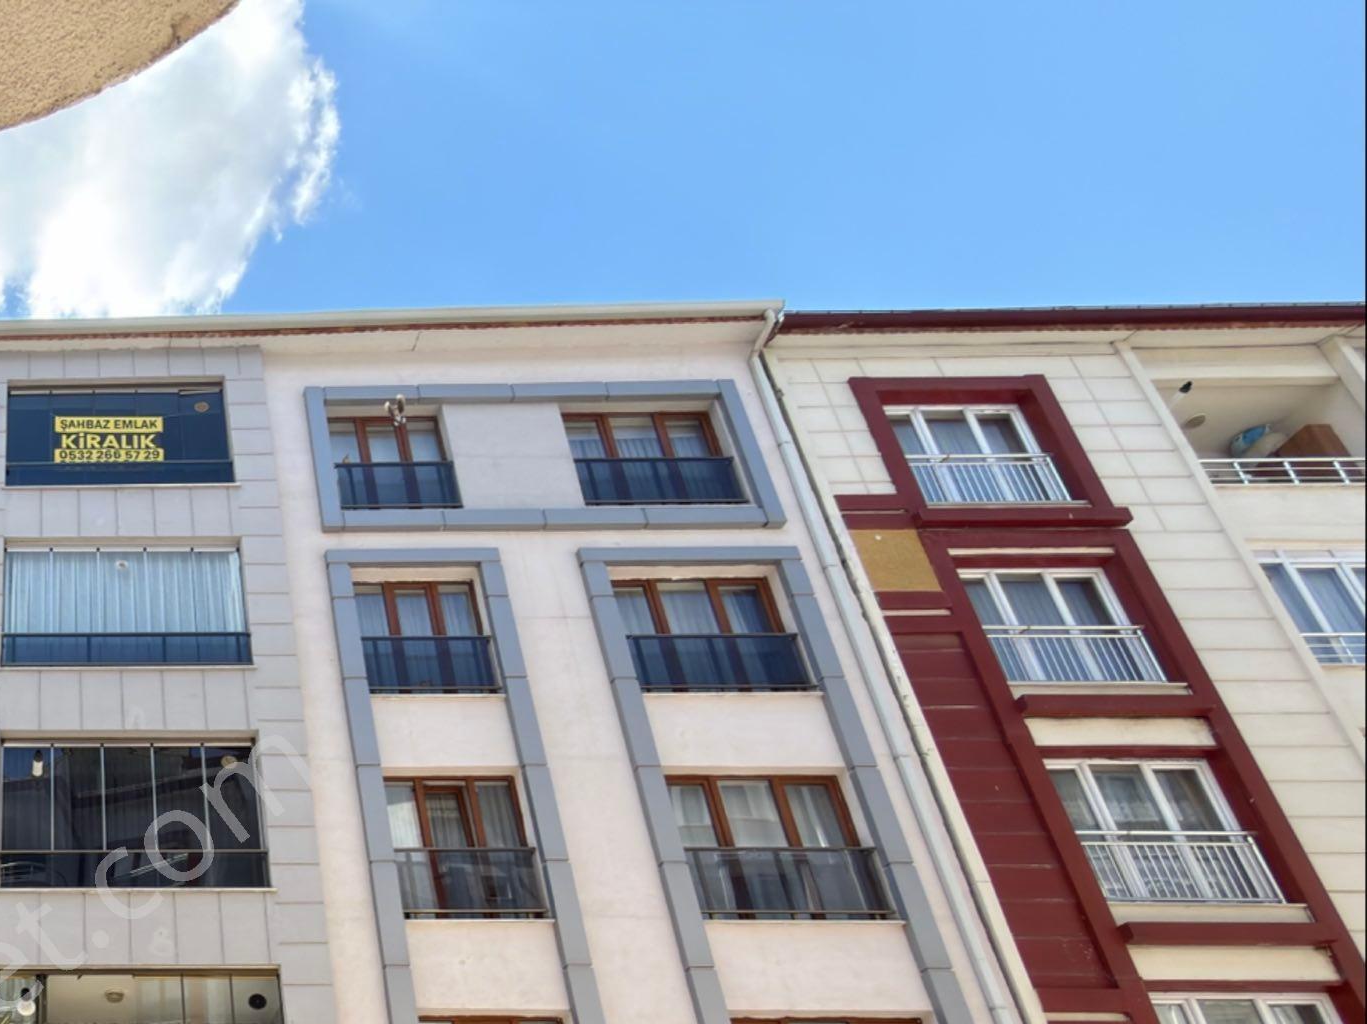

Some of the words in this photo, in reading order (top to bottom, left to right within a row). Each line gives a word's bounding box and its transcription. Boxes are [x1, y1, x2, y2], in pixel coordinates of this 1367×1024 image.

[60, 419, 111, 431] ŞAHBAZ
[114, 419, 158, 429] EMLAK
[61, 432, 157, 449] KİRALIK
[59, 450, 93, 460] 0532
[125, 450, 141, 459] 57
[143, 450, 160, 460] 29
